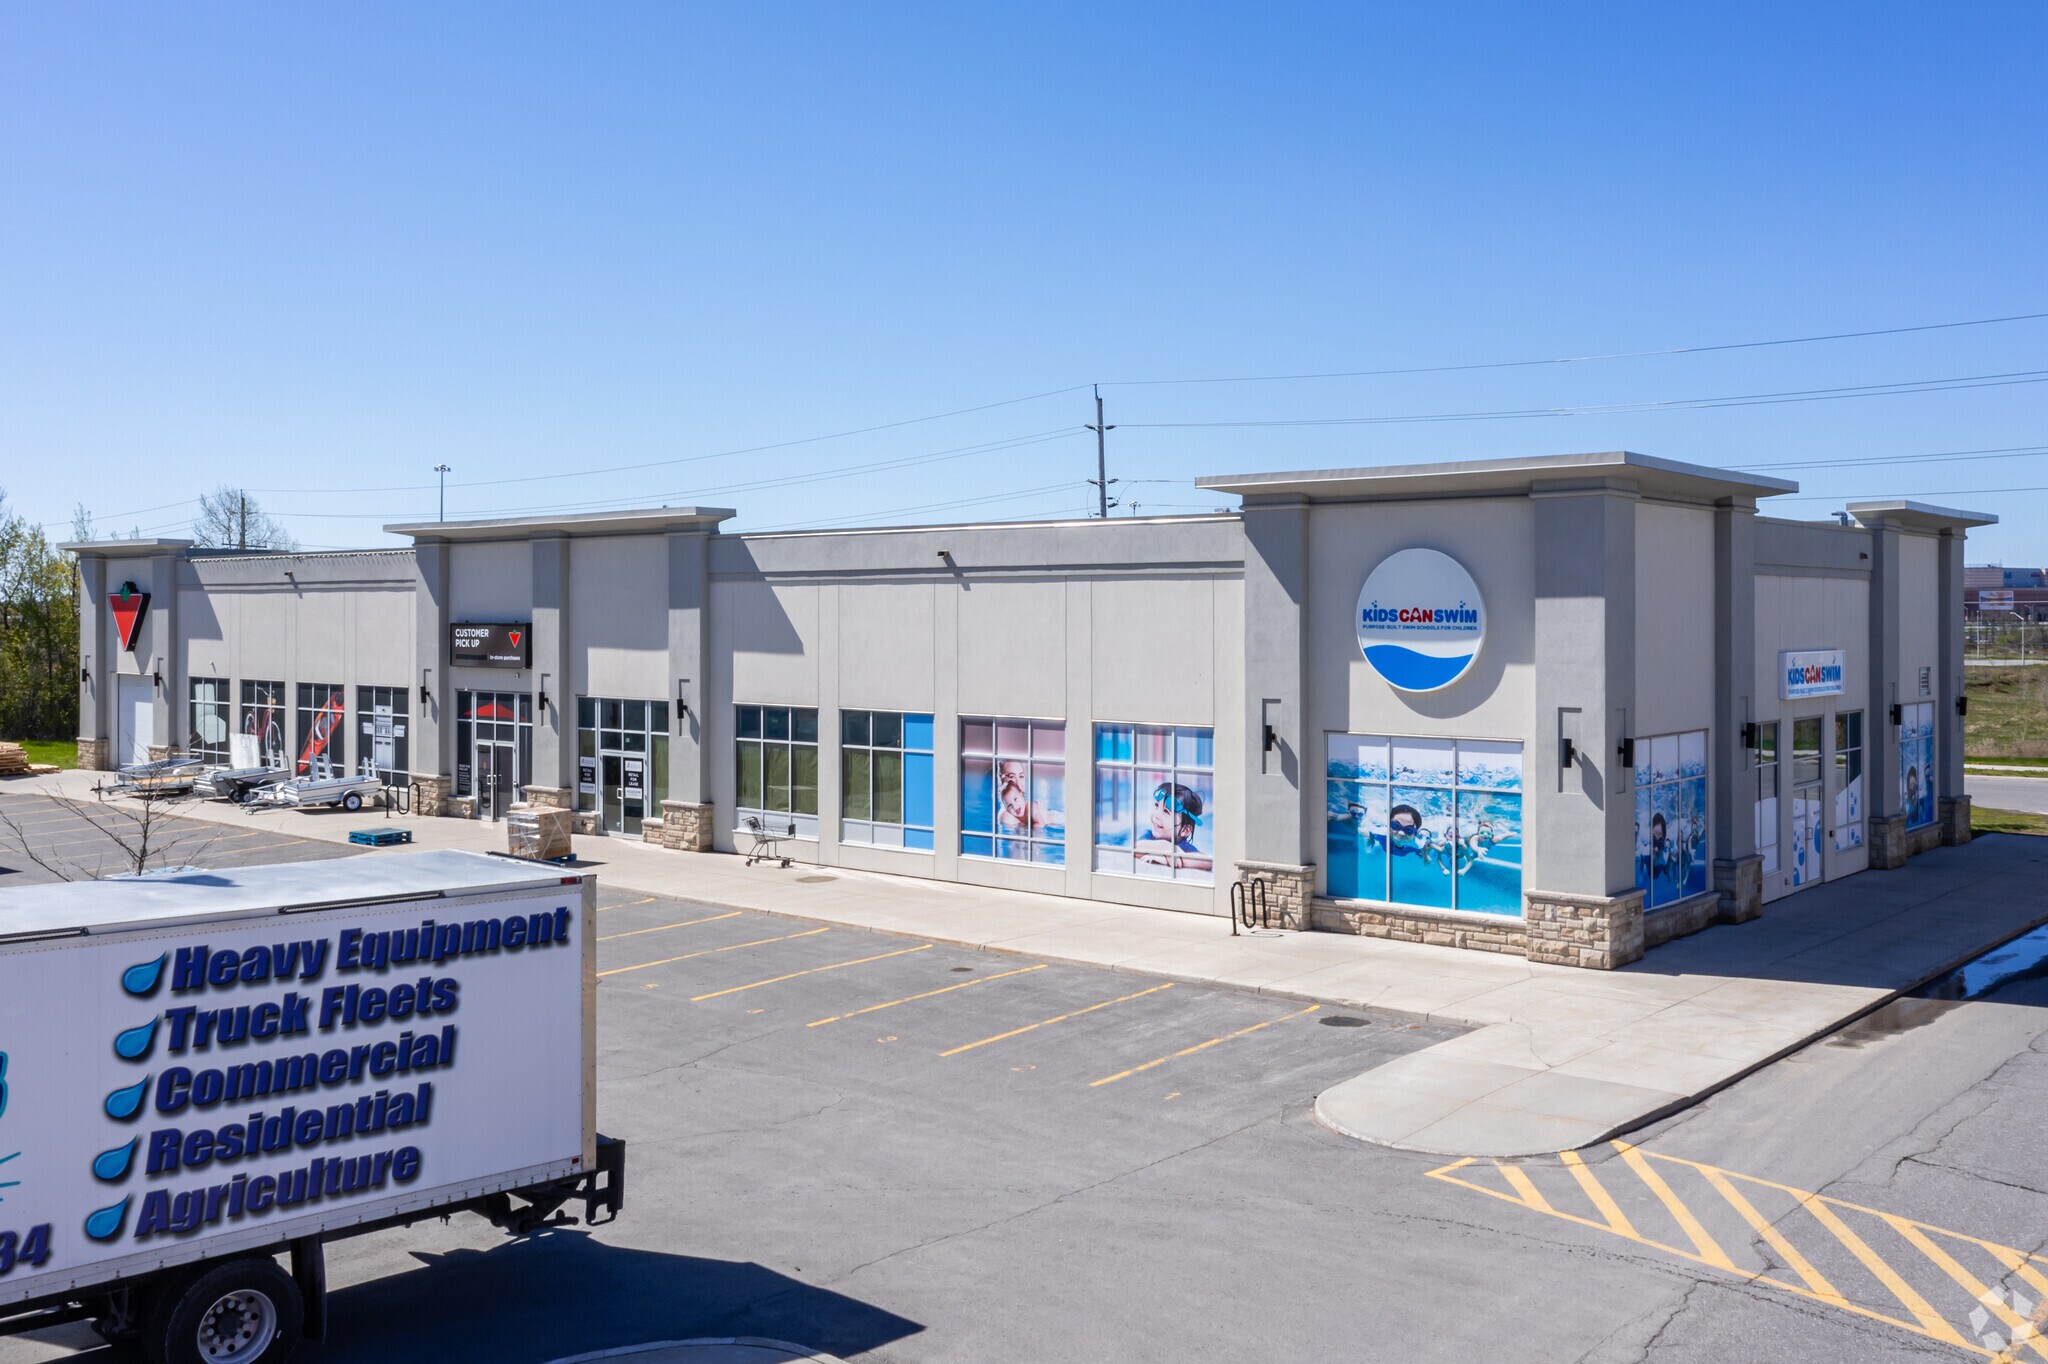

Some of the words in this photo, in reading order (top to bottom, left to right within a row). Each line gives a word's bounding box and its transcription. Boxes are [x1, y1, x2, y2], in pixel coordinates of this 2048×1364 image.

[455, 629, 489, 638] CUSTOMER
[455, 639, 470, 647] PICK
[471, 639, 480, 647] UP
[170, 937, 329, 992] Heavy
[336, 906, 570, 970] Equipment
[164, 991, 311, 1052] Truck
[318, 975, 459, 1029] Fleets
[154, 1023, 456, 1113] Commercial
[144, 1081, 432, 1176] Residential
[133, 1145, 420, 1239] Agriculture
